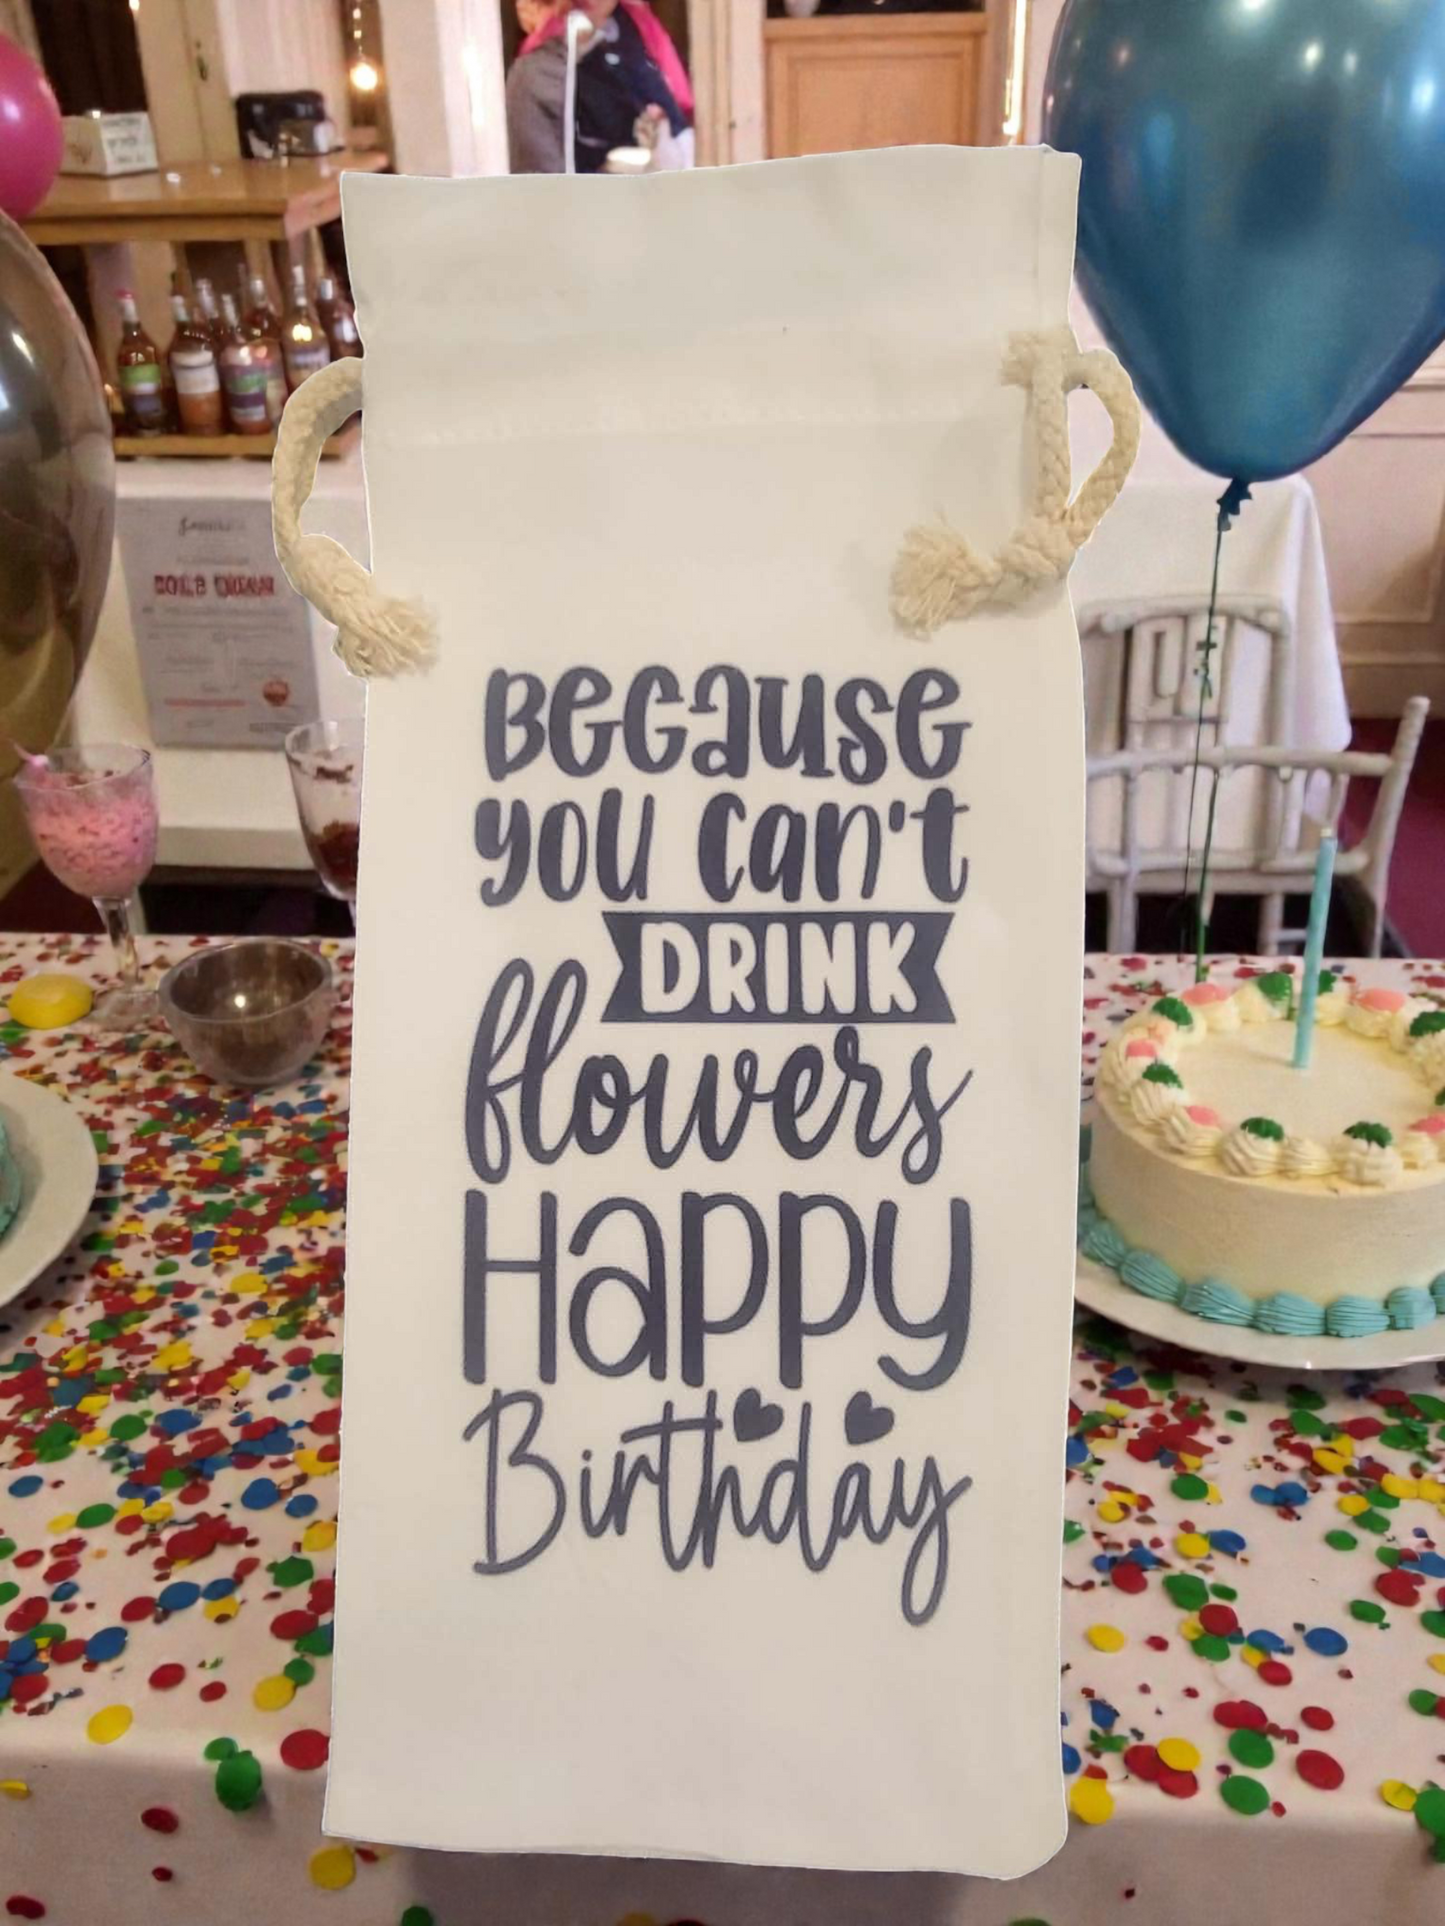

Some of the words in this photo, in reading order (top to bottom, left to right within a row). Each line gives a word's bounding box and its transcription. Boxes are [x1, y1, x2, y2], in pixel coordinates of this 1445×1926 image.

[698, 787, 969, 904] can't
[640, 922, 918, 1014] DRINK
[465, 957, 972, 1185] flowers
[463, 1189, 972, 1391] Happy
[463, 1389, 972, 1627] Birthday
